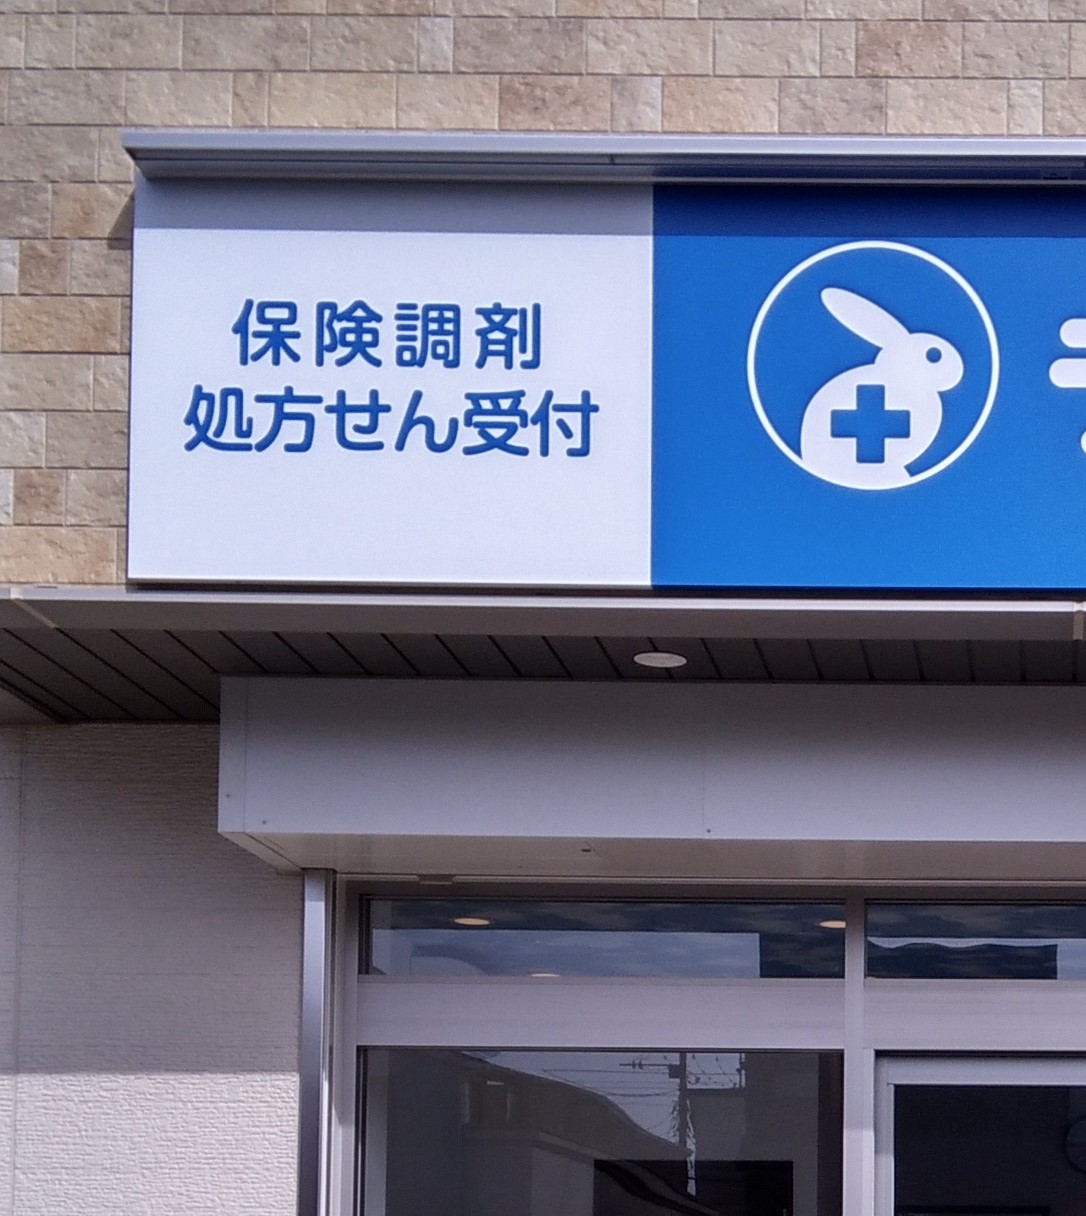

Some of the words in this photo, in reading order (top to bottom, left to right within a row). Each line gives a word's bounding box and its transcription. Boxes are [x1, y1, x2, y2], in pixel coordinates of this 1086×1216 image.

[231, 298, 542, 370] 保険調剤
[183, 384, 600, 458] 処方せん受付
